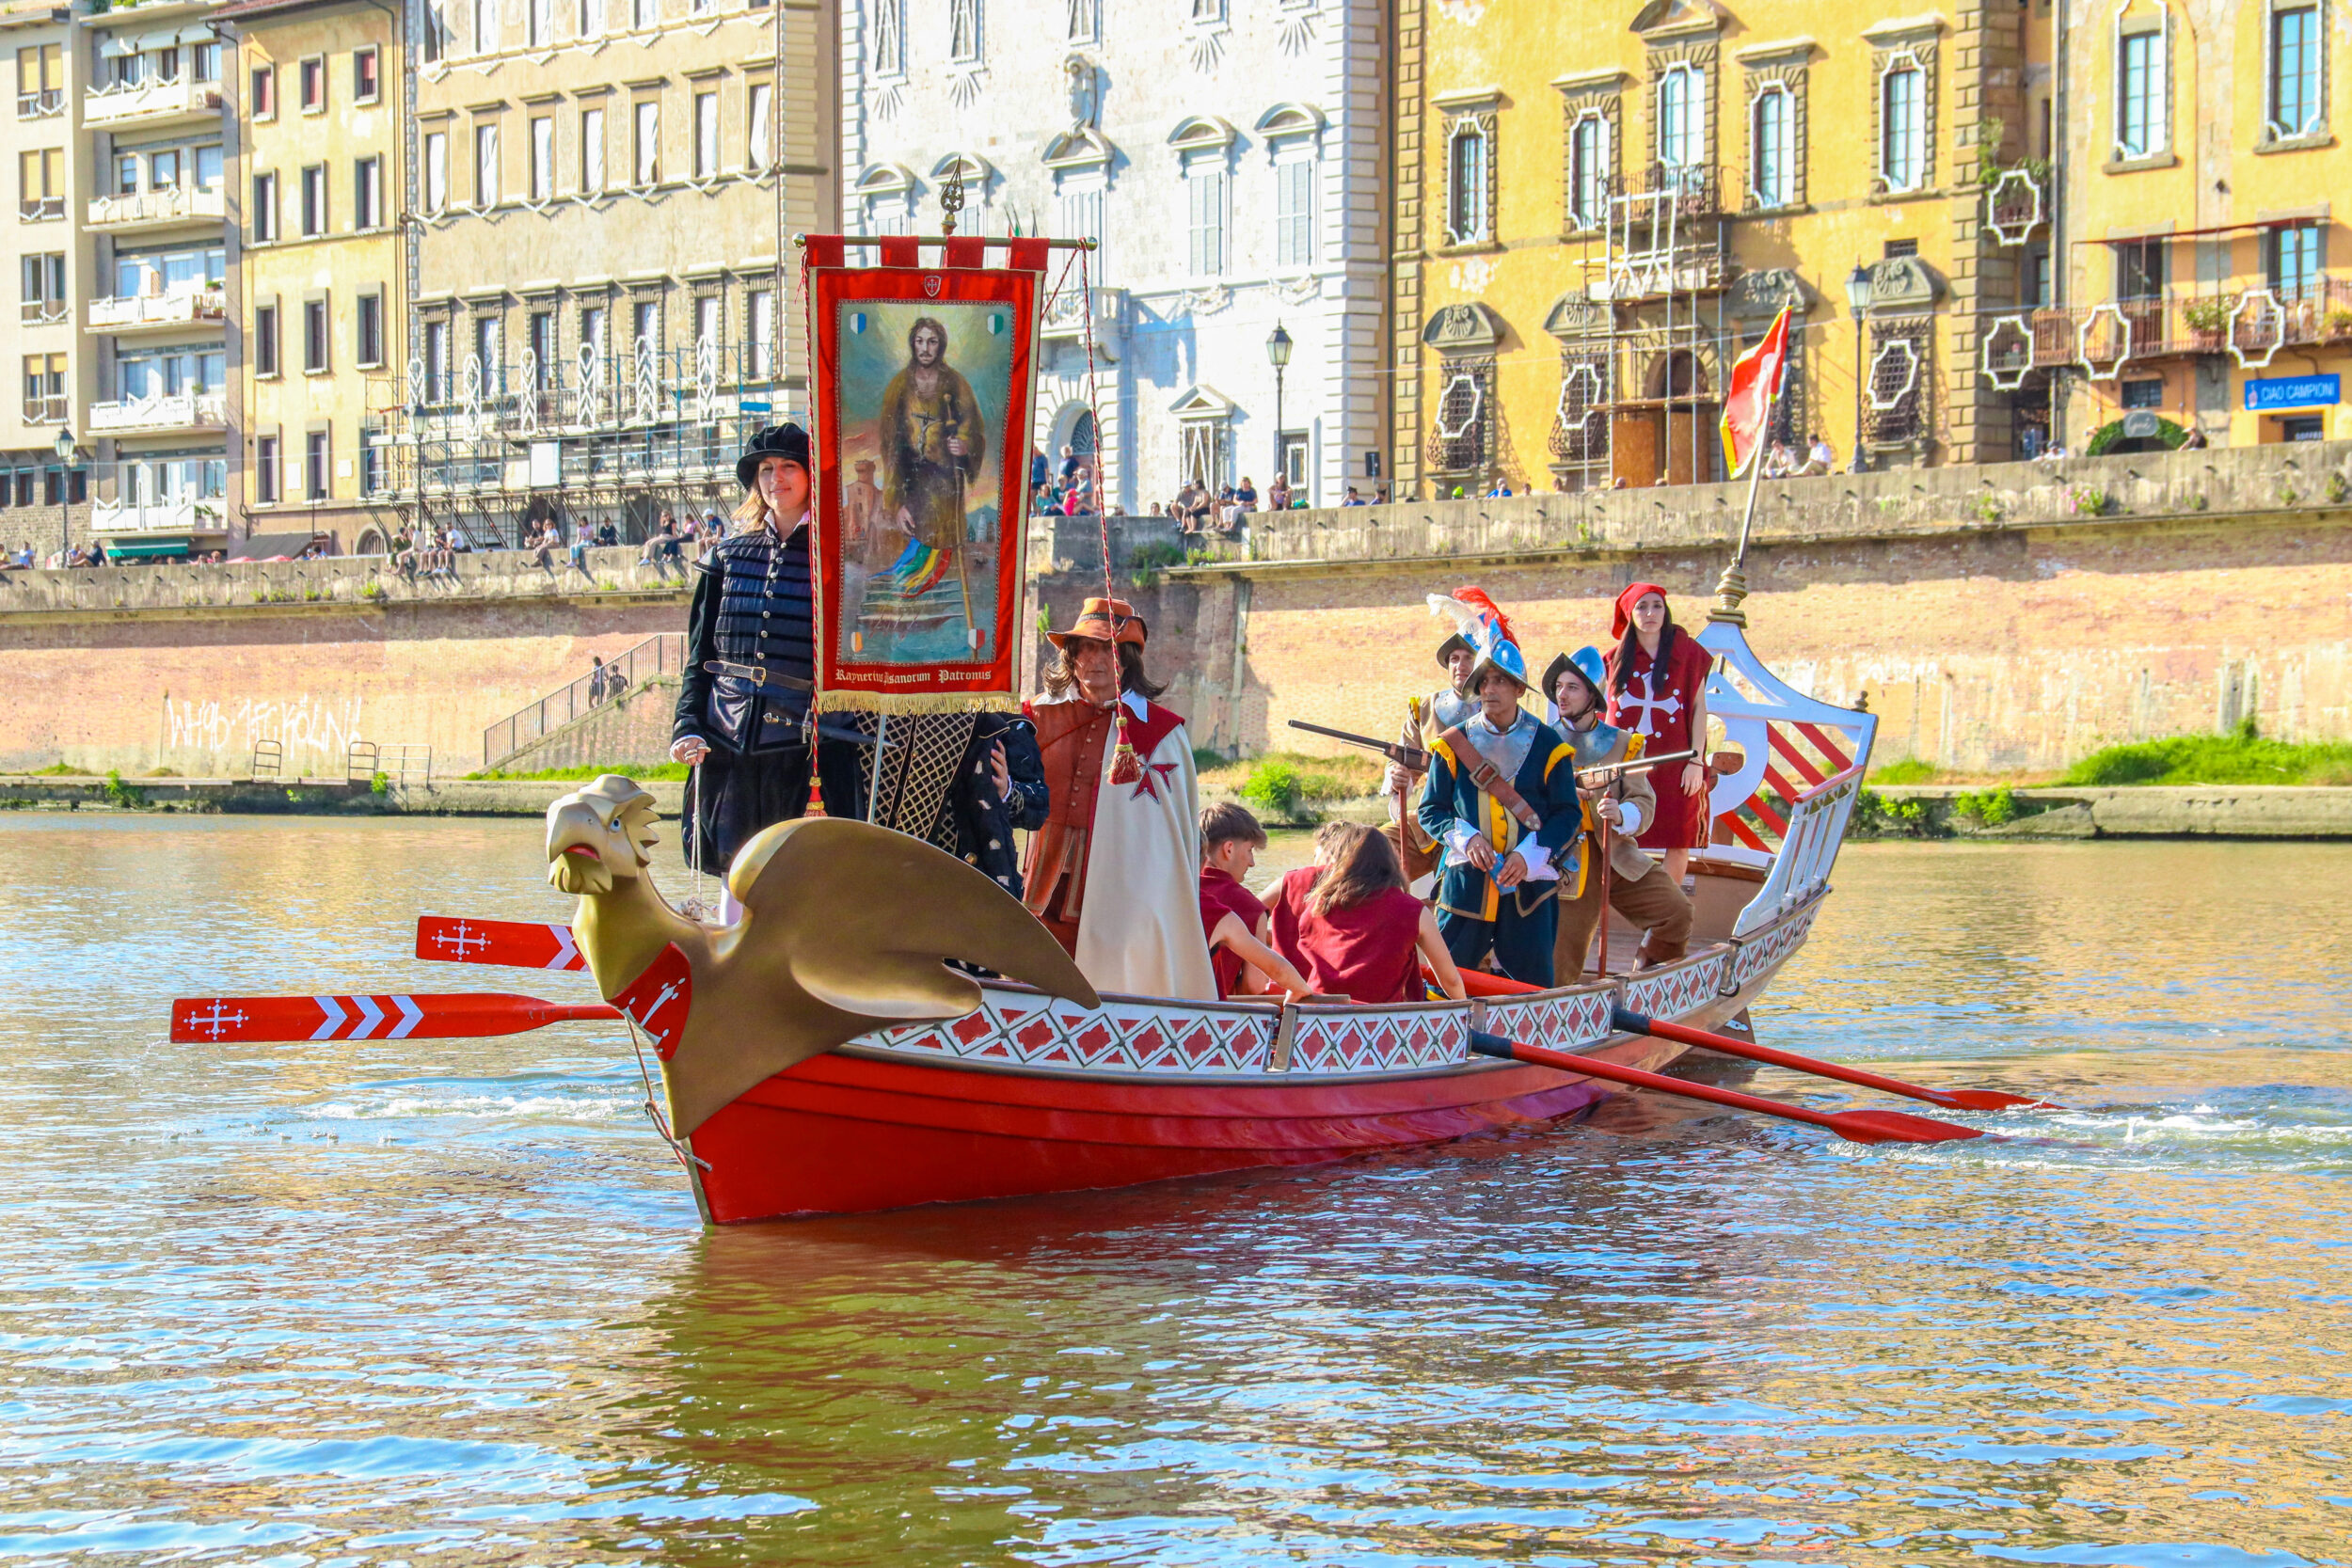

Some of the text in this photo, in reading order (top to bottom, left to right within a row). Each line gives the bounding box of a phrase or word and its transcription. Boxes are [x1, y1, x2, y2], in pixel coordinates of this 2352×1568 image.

[2261, 382, 2335, 401] CIAO CAMPIONI
[835, 669, 883, 684] Raynerius
[938, 669, 992, 684] Patronus
